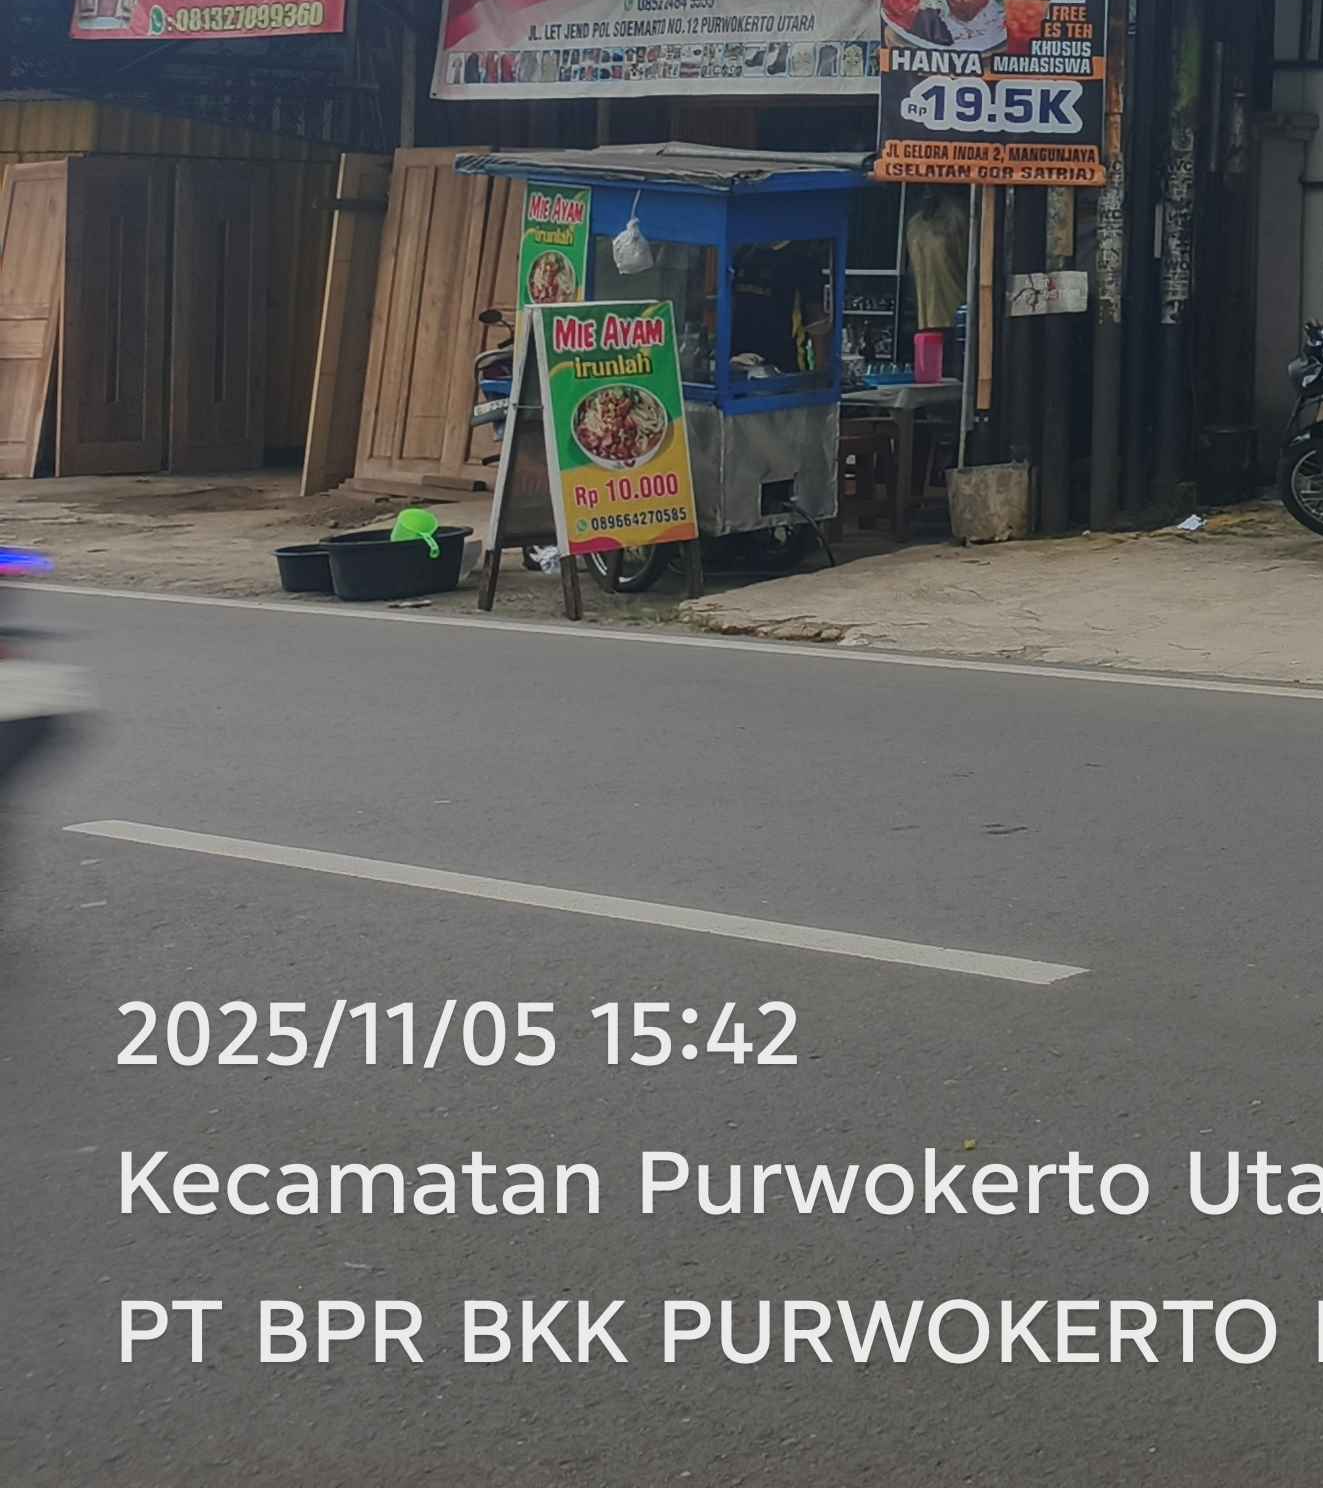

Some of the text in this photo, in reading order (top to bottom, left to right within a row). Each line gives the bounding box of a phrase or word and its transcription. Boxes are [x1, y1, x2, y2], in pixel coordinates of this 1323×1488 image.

[1052, 6, 1088, 22] FREE
[592, 21, 610, 38] POL
[700, 14, 775, 34] PURWOKERTO
[776, 13, 817, 33] UTARA
[1044, 23, 1094, 40] ES TEH
[1031, 40, 1093, 58] KHUSUS
[891, 49, 984, 76] HANYA
[993, 55, 1091, 75] MAHASISWA
[907, 84, 1073, 125] Rp 19.5K
[902, 144, 950, 160] GELORA
[1007, 146, 1097, 163] MANGUNJAYA
[885, 163, 971, 178] (SELATAN
[1020, 166, 1096, 182] SATRIA)
[554, 313, 665, 352] MIE AYAM
[575, 473, 679, 509] Rp 10.000
